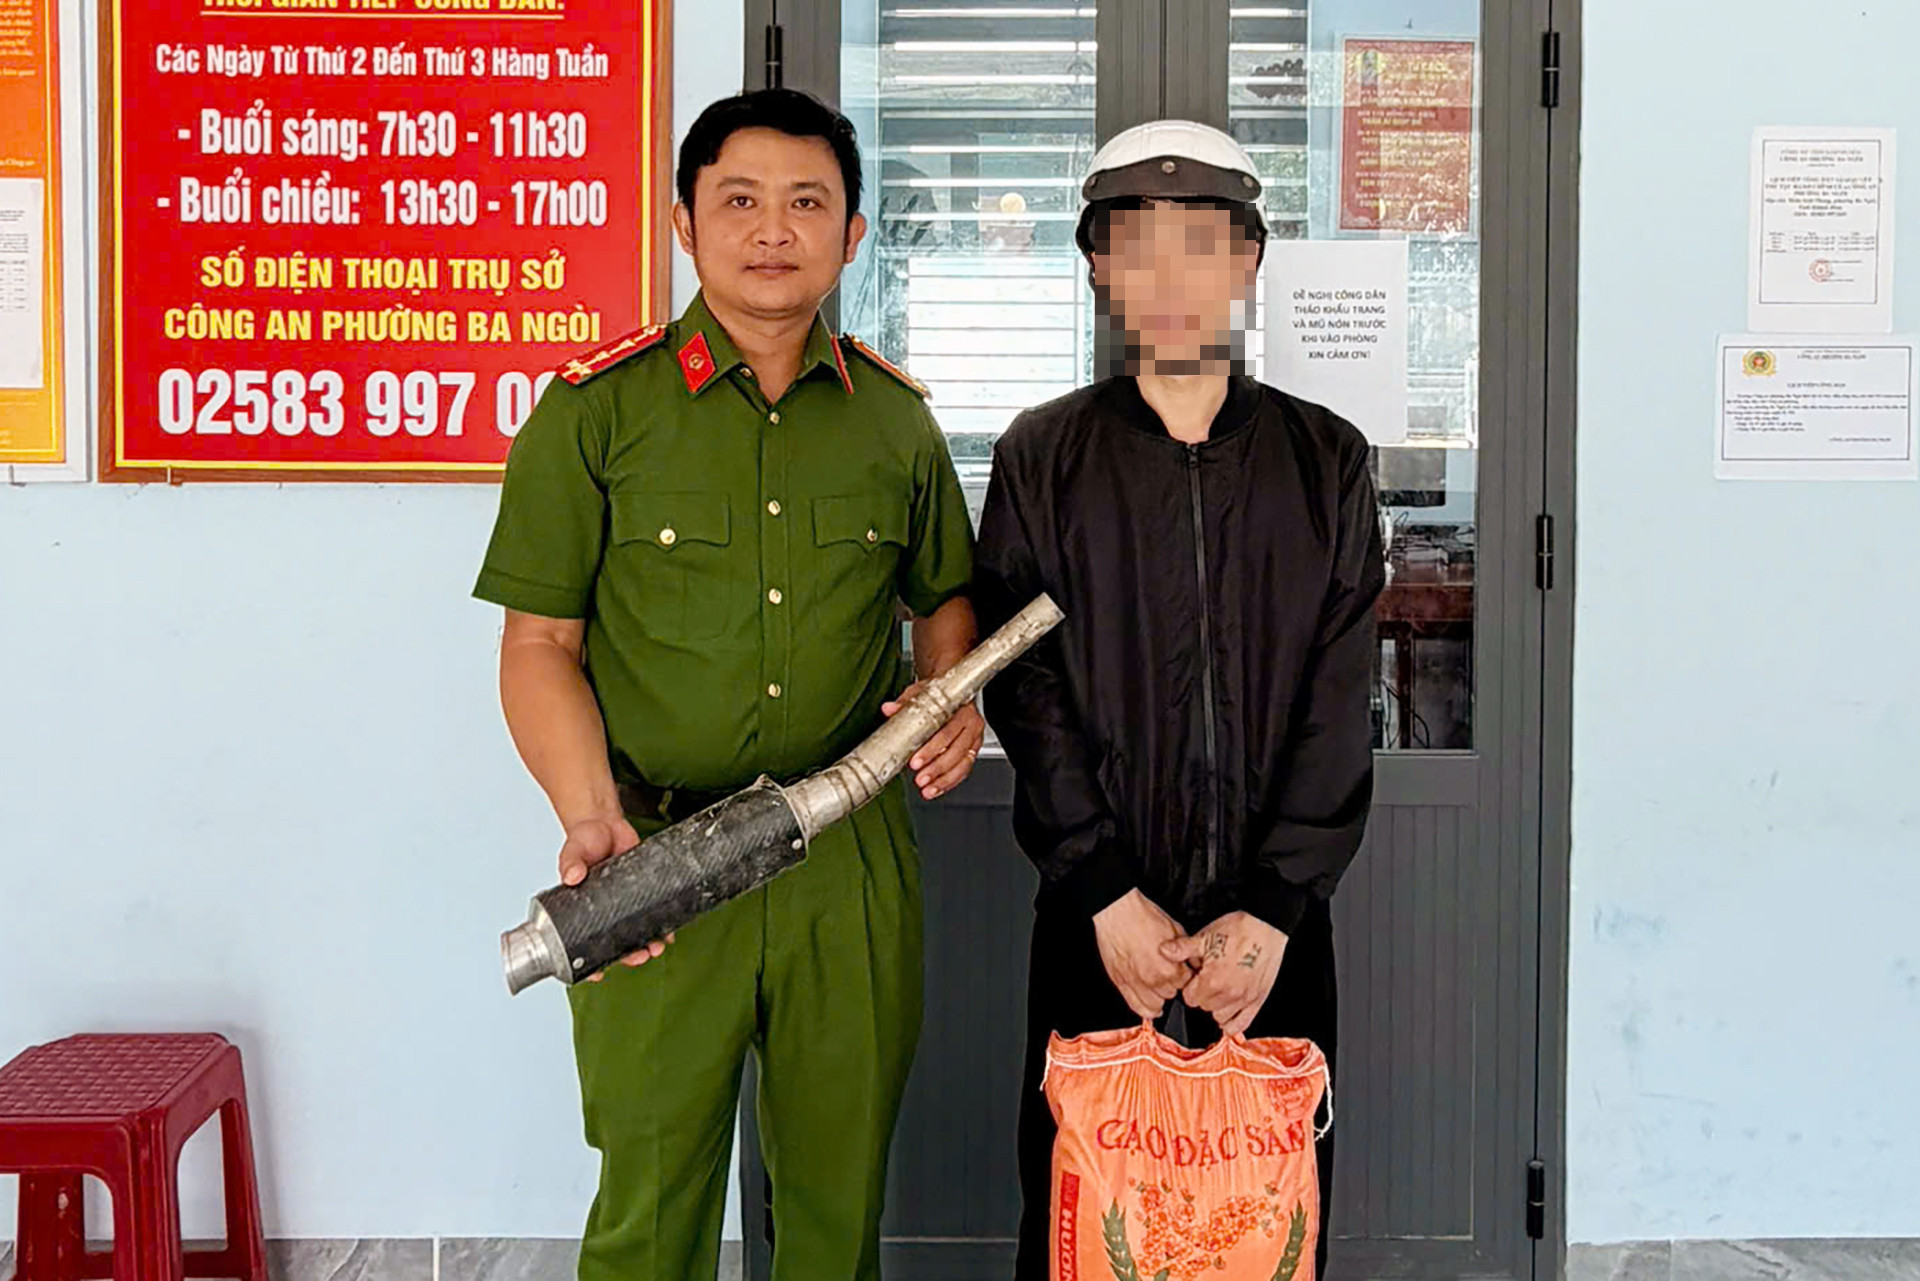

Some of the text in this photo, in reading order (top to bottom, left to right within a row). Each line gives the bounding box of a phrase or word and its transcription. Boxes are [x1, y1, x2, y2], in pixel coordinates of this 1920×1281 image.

[156, 41, 609, 80] Các Ngày Từ Thứ 2 Đến Thứ 3 Hàng Tuần
[177, 98, 588, 162] - Buổi sáng: 7h30 - 11h30
[156, 166, 608, 226] - Buổi chiều: 13h30 - 17h00
[200, 245, 567, 296] SỐ ĐIỆN THOẠI TRỤ SỞ
[1308, 290, 1333, 301] NGHỊ
[1334, 288, 1363, 300] CÔNG
[1365, 288, 1386, 300] DÂN
[1353, 305, 1386, 314] TRANG
[164, 302, 600, 343] CÔNG AN PHƯỜNG BA NGÒI
[1301, 333, 1378, 343] KHI VÀO PHÒNG
[1308, 351, 1324, 359] XIN
[158, 367, 557, 438] 02583 997 0
[1097, 1116, 1306, 1171] GẠO ĐẶC SẢN
